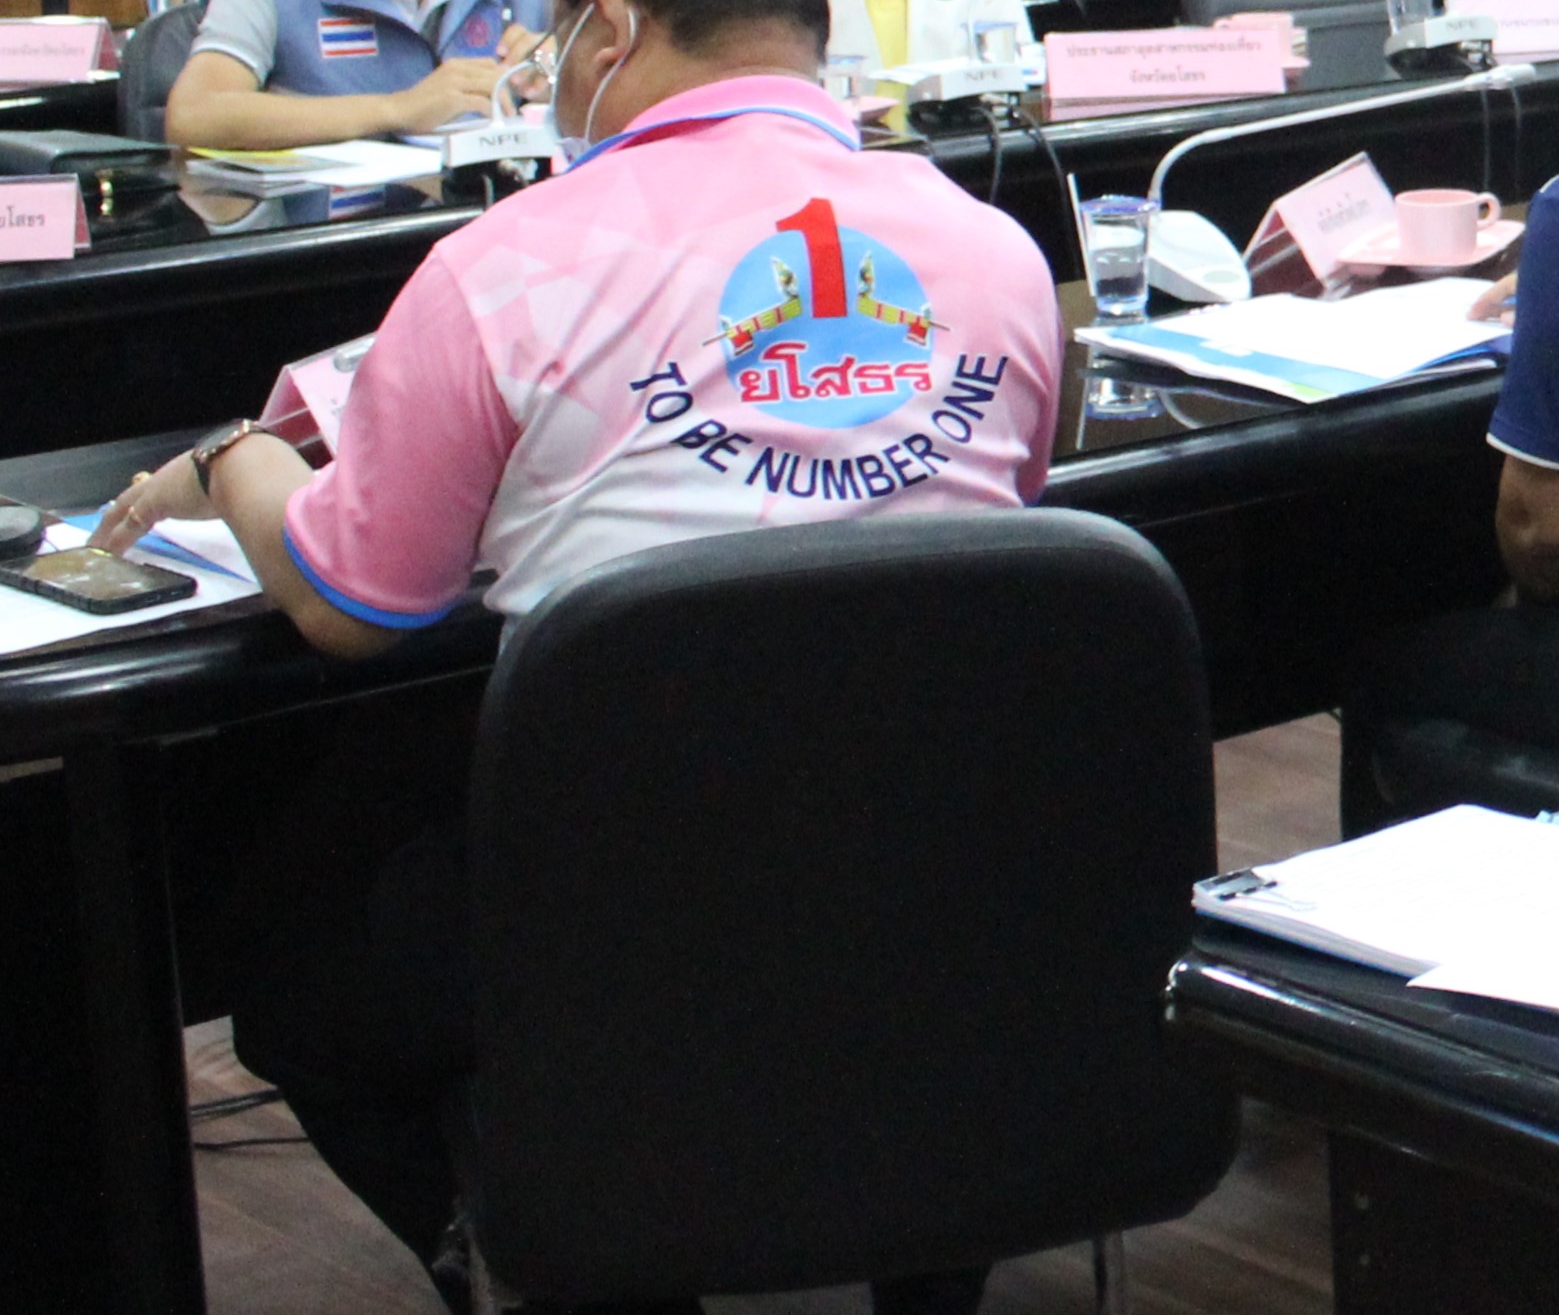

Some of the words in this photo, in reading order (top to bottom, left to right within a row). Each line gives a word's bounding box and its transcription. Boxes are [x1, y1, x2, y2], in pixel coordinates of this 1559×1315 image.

[479, 132, 528, 147] NPE
[775, 196, 848, 319] 1
[738, 342, 933, 404] ยโสธร
[630, 361, 694, 425] TO
[670, 418, 752, 473] BE
[745, 433, 950, 502] NUMBER
[931, 353, 1009, 444] ONE
